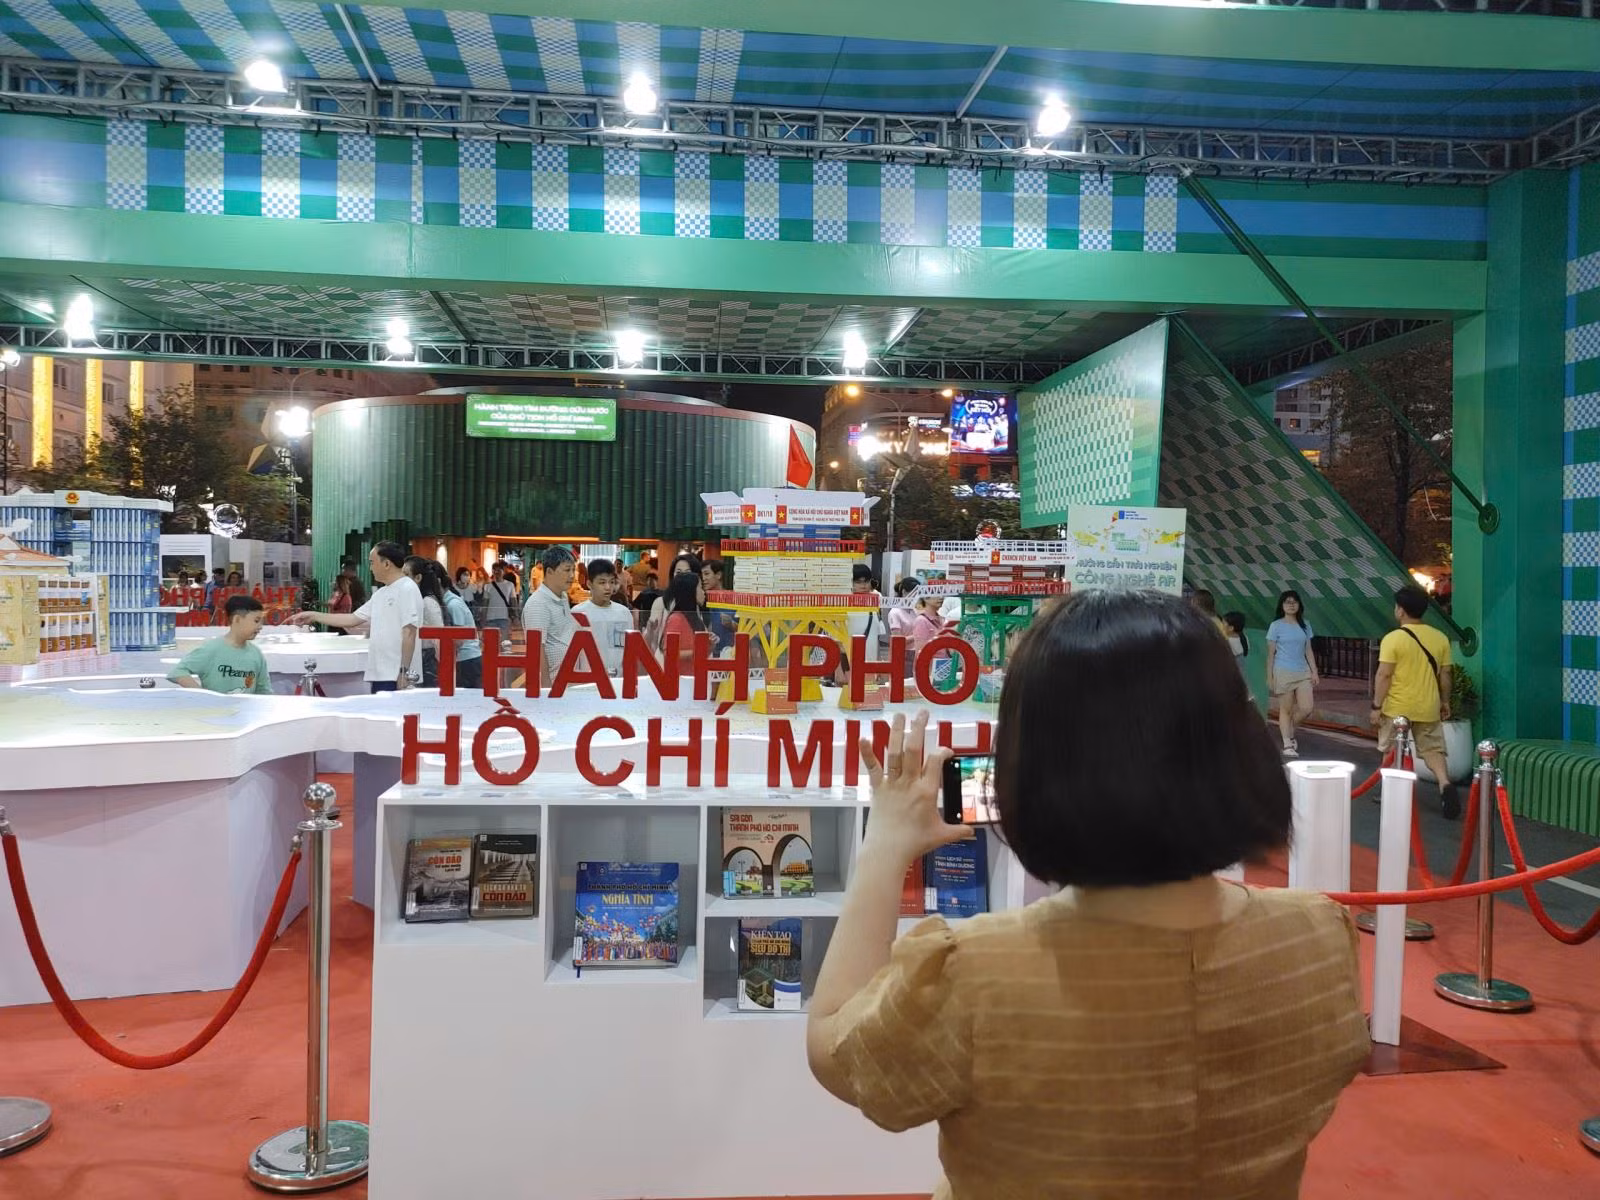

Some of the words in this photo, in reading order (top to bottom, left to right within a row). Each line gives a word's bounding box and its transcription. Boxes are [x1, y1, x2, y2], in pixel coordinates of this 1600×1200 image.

[1075, 569, 1114, 585] CÔNG
[1117, 571, 1156, 589] NGHỆ
[1158, 575, 1176, 587] AR
[419, 612, 751, 702] THÀNH
[787, 620, 981, 706] PHỐ
[401, 697, 541, 787] HỒ
[575, 702, 731, 788] CHÍ
